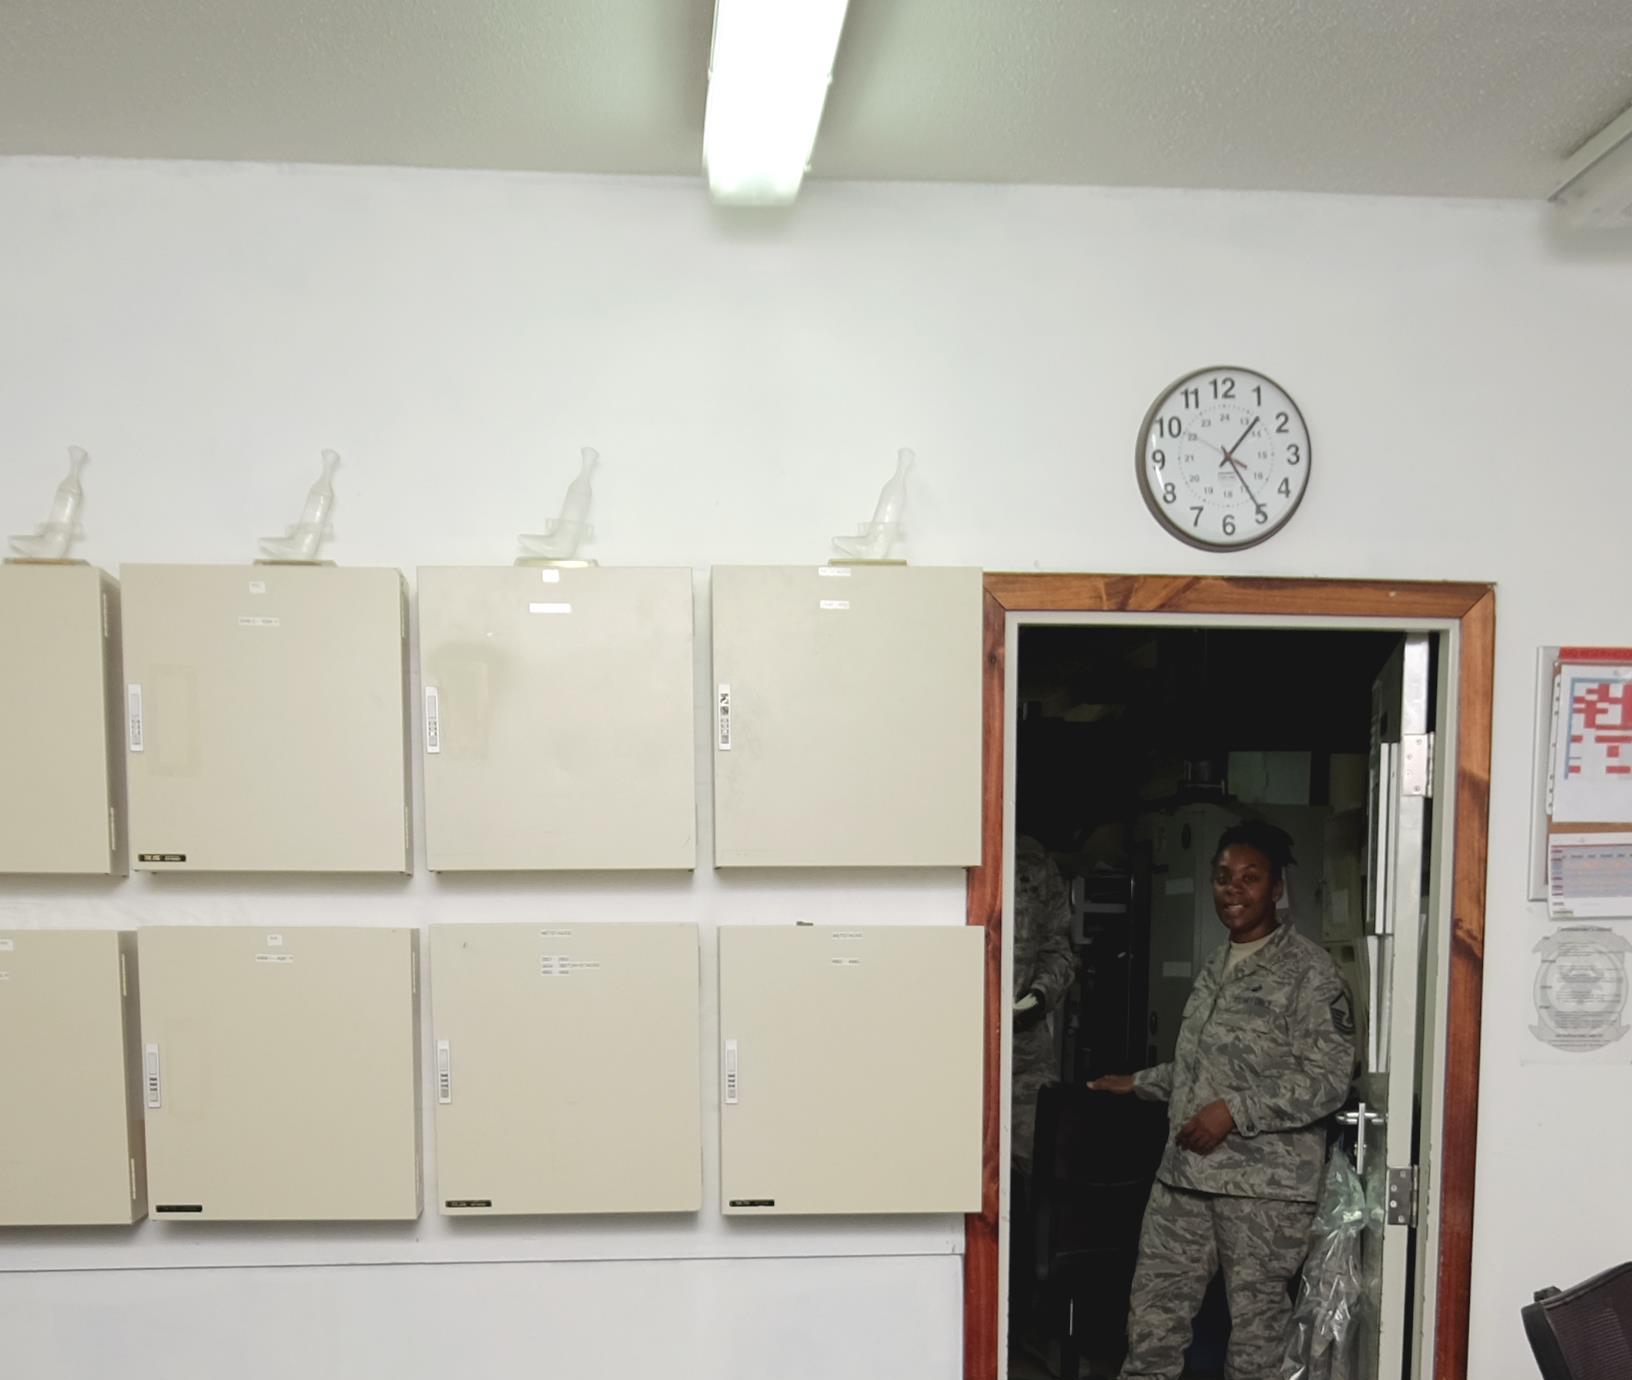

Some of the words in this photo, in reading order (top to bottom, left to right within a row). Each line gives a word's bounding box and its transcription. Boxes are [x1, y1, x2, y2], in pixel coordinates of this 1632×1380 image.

[1180, 388, 1200, 409] 11
[1209, 377, 1236, 399] 12
[1252, 385, 1262, 407] 1
[1155, 416, 1181, 438] 10
[1275, 412, 1290, 433] 2
[1151, 449, 1165, 471] 9
[1286, 444, 1300, 465] 3
[1162, 482, 1176, 504] 8
[1277, 477, 1291, 498] 4
[1190, 506, 1204, 527] 7
[1255, 504, 1268, 524] 5
[1222, 515, 1236, 536] 6
